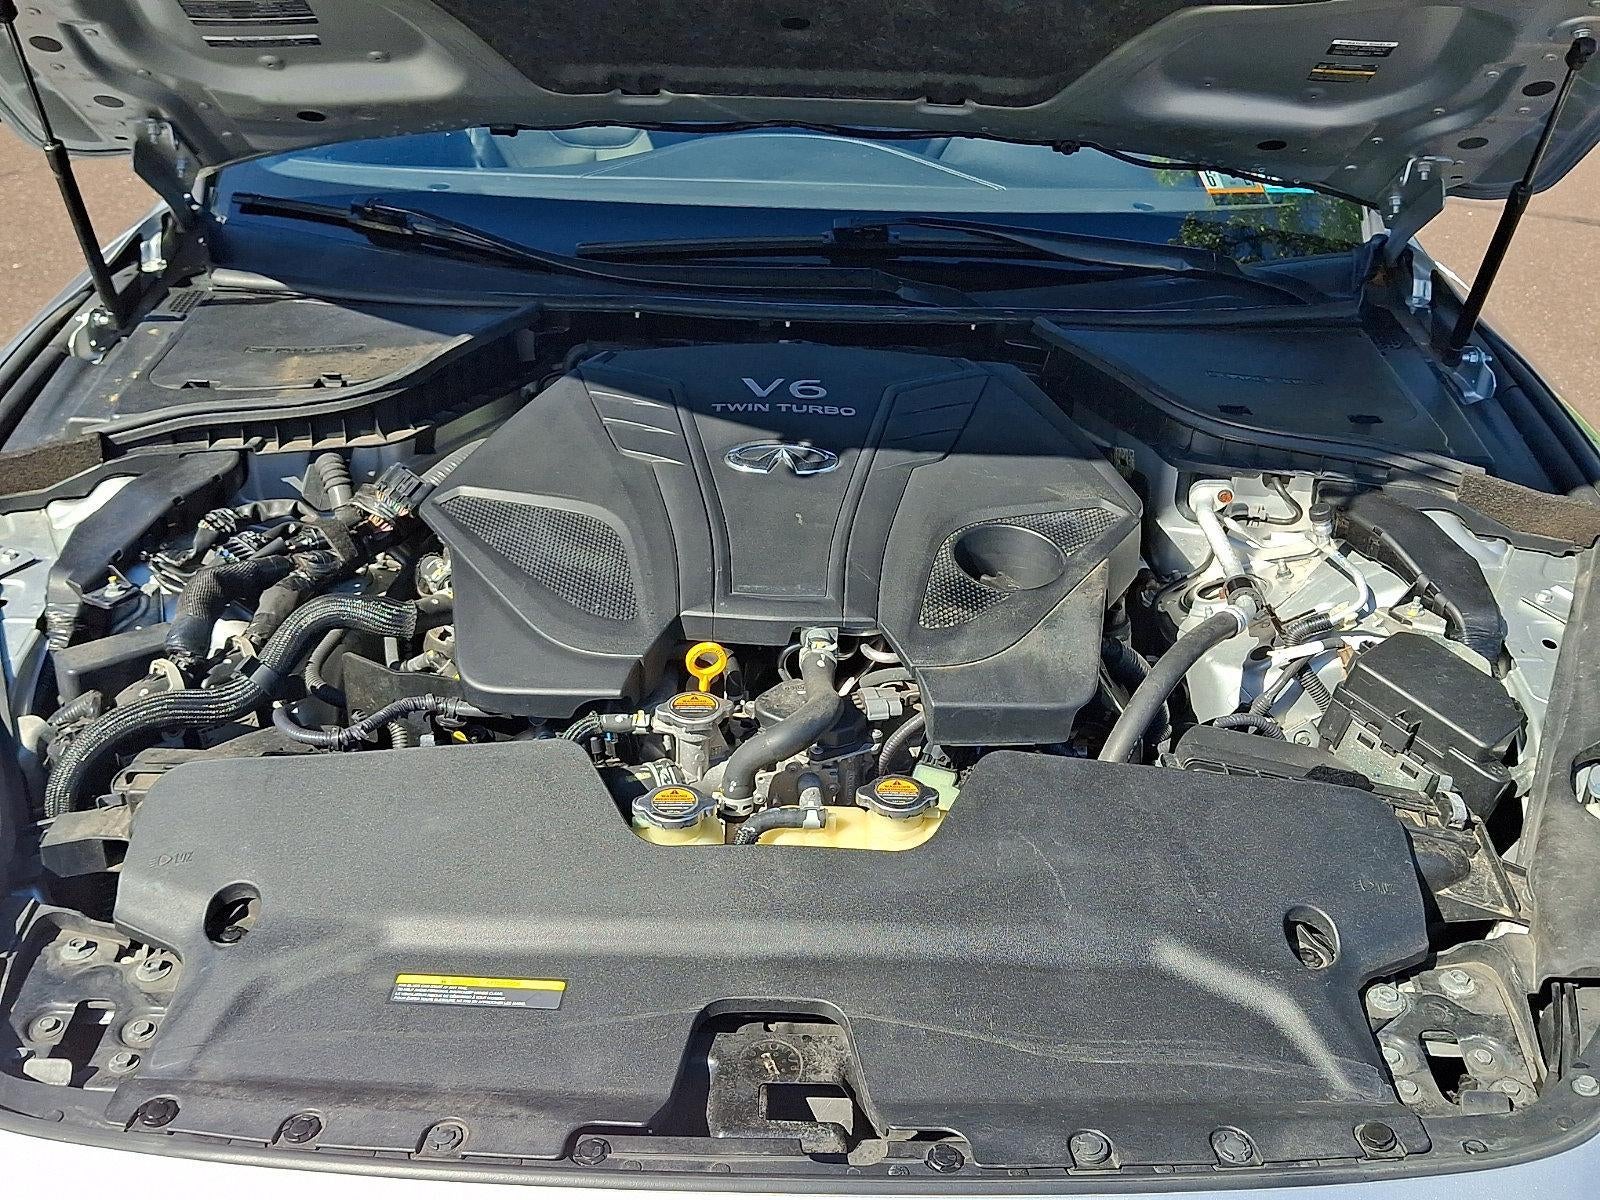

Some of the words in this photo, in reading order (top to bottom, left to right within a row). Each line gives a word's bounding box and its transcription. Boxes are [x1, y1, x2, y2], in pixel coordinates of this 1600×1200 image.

[741, 377, 828, 399] V6
[711, 403, 770, 413] TWIN
[776, 403, 857, 417] TURBO
